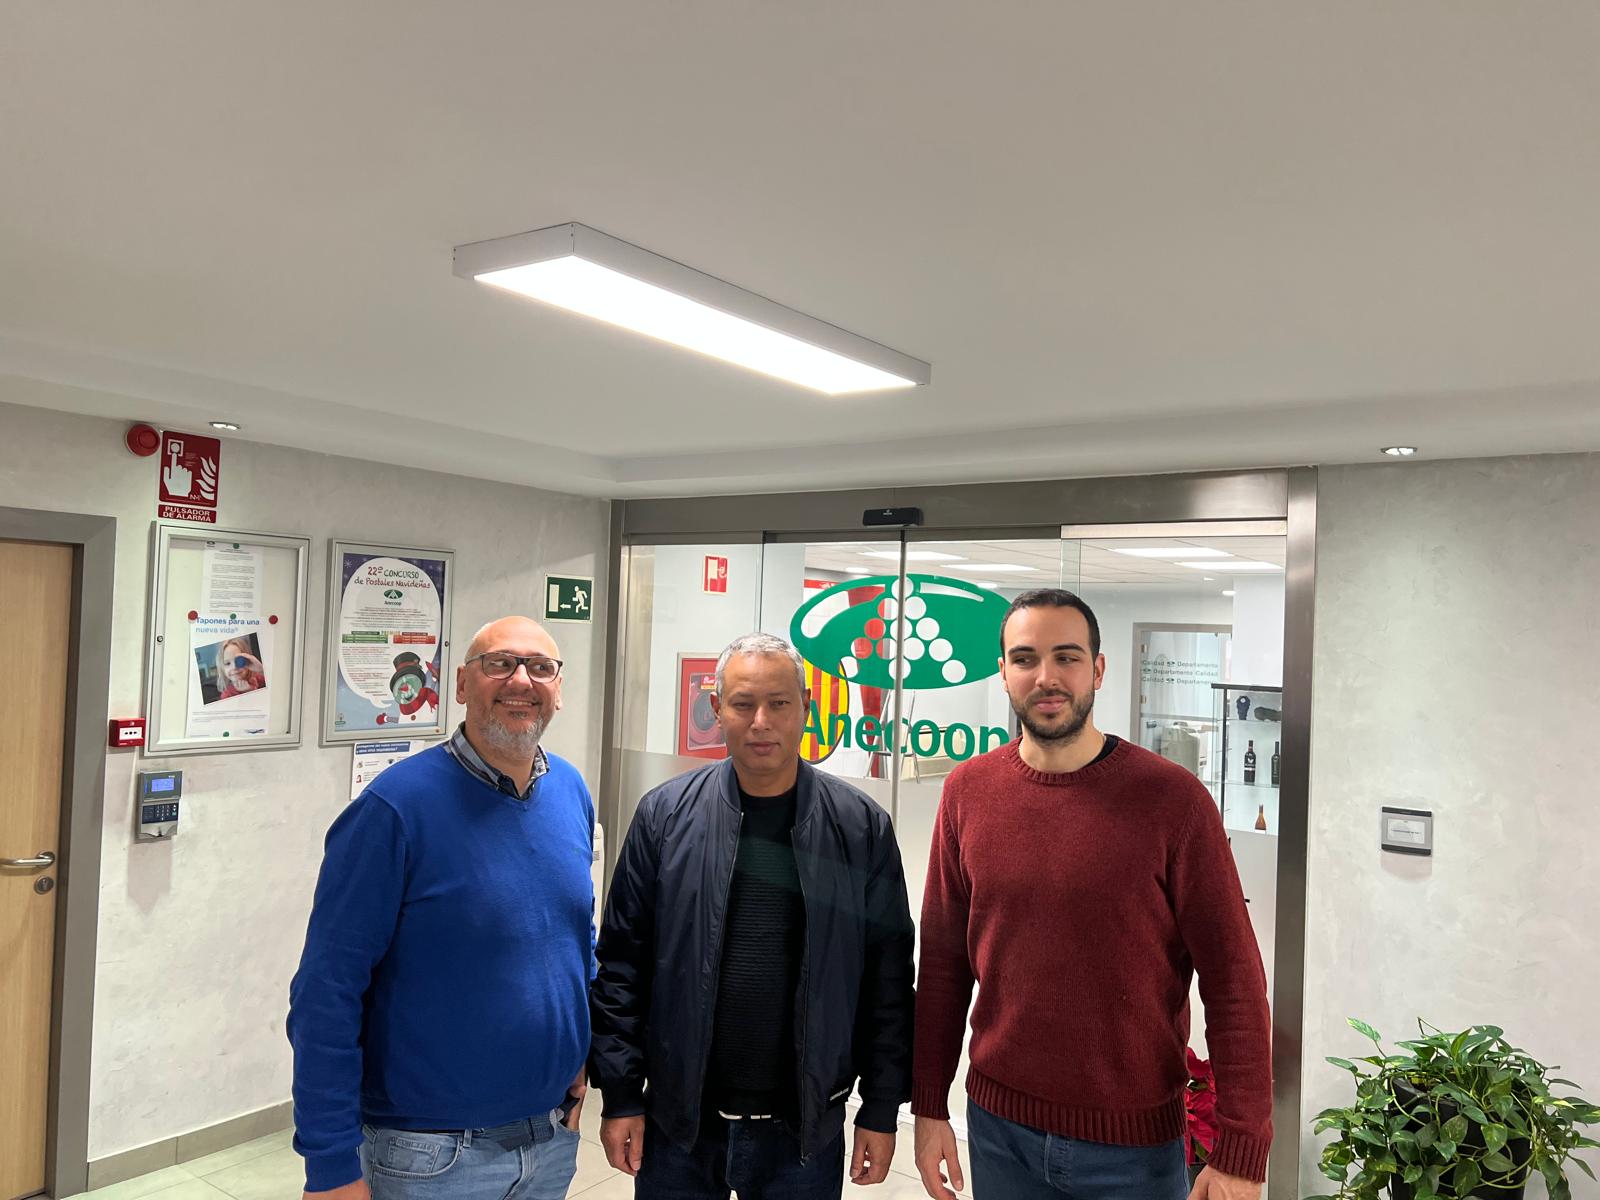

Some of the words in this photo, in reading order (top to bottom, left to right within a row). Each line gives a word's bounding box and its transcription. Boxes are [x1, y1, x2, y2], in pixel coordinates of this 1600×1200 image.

[165, 506, 210, 516] PULSADOR
[176, 513, 211, 522] ALARMA
[383, 569, 419, 579] CONCURSO
[354, 577, 364, 585] de
[366, 578, 394, 587] Postales
[395, 580, 431, 589] Navideñas
[196, 617, 227, 625] Tapones
